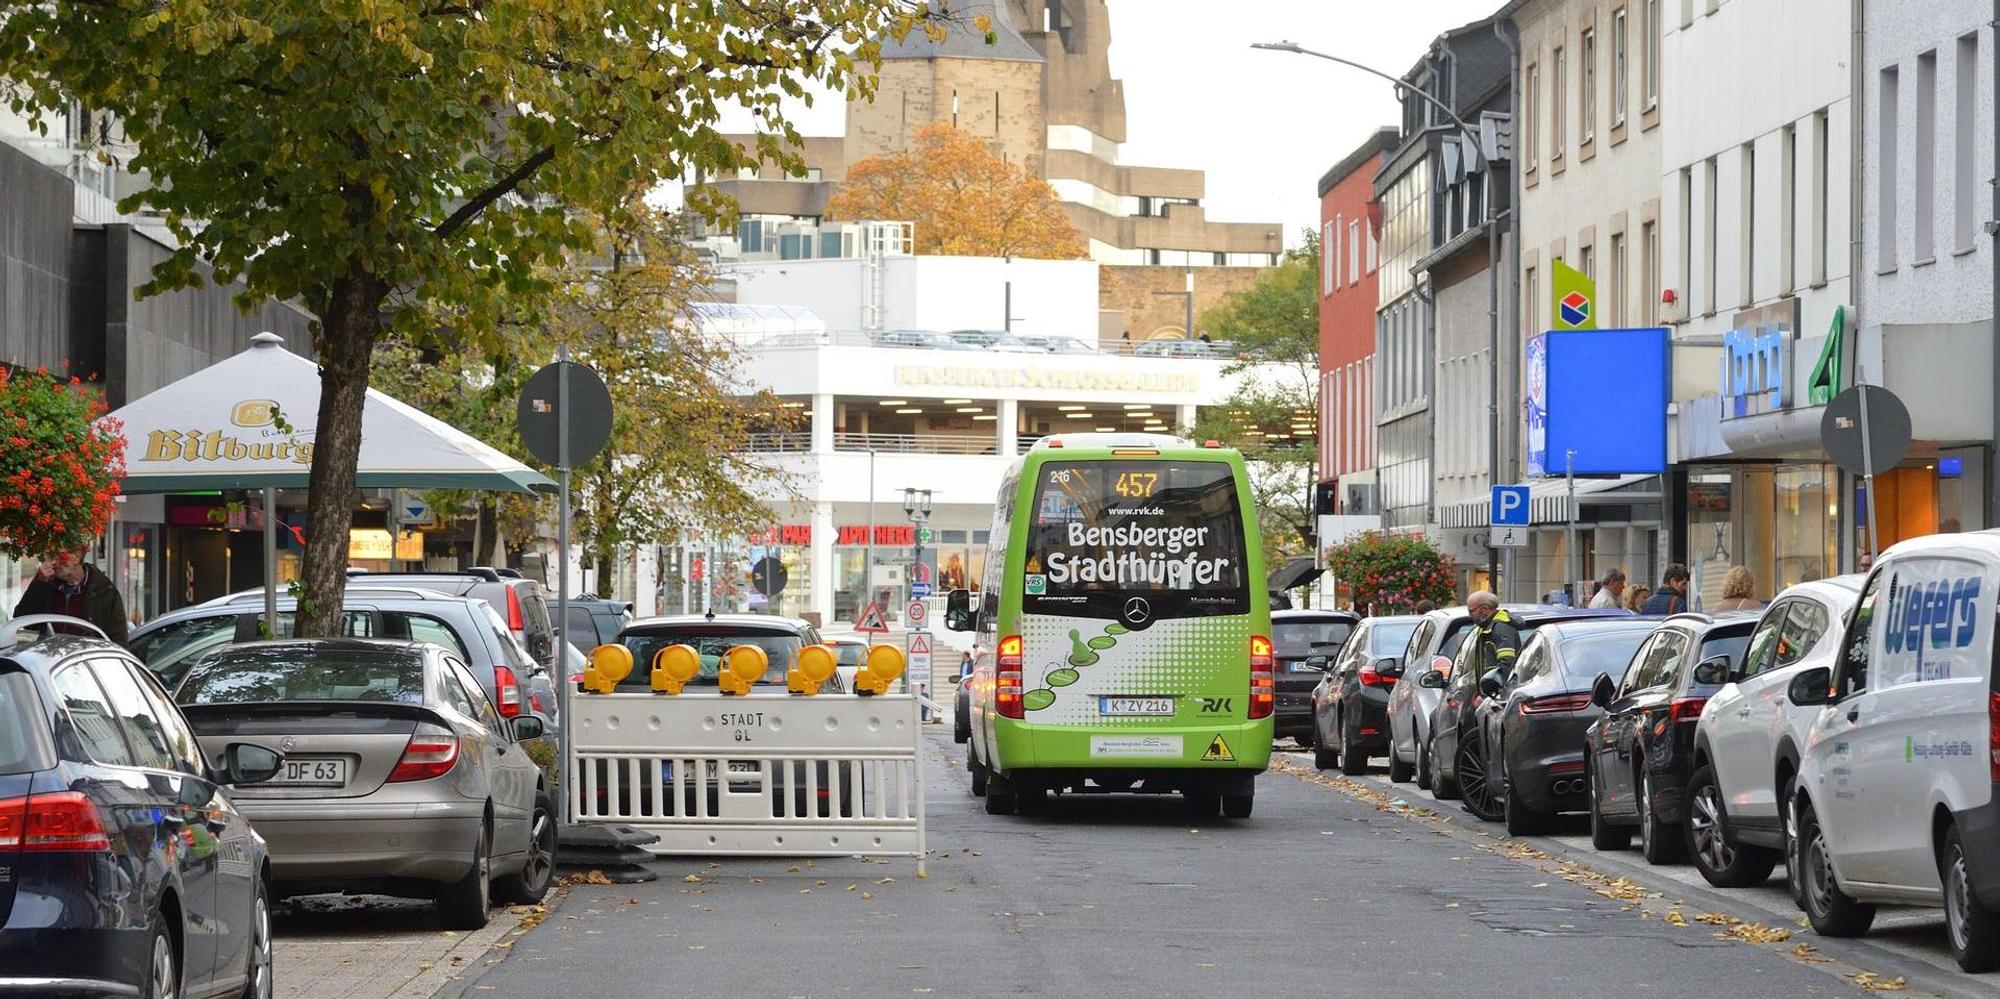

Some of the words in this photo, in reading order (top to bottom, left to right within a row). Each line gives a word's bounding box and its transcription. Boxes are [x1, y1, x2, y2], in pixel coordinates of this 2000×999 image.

[139, 428, 316, 464] Bitburg
[1050, 470, 1070, 483] 216
[1115, 473, 1158, 497] 457
[1108, 507, 1165, 516] www.rvk.de
[1500, 490, 1521, 520] P
[781, 525, 811, 544] PAR
[838, 525, 914, 545] APOHEKE
[1068, 522, 1208, 553] Bensberger
[1047, 551, 1229, 589] Stadthüpfer
[912, 607, 920, 616] 20
[1111, 700, 1119, 711] K
[1128, 700, 1142, 712] ZY
[1146, 700, 1168, 711] 216
[721, 713, 763, 727] STADT
[287, 763, 310, 779] DF
[314, 763, 337, 779] 63
